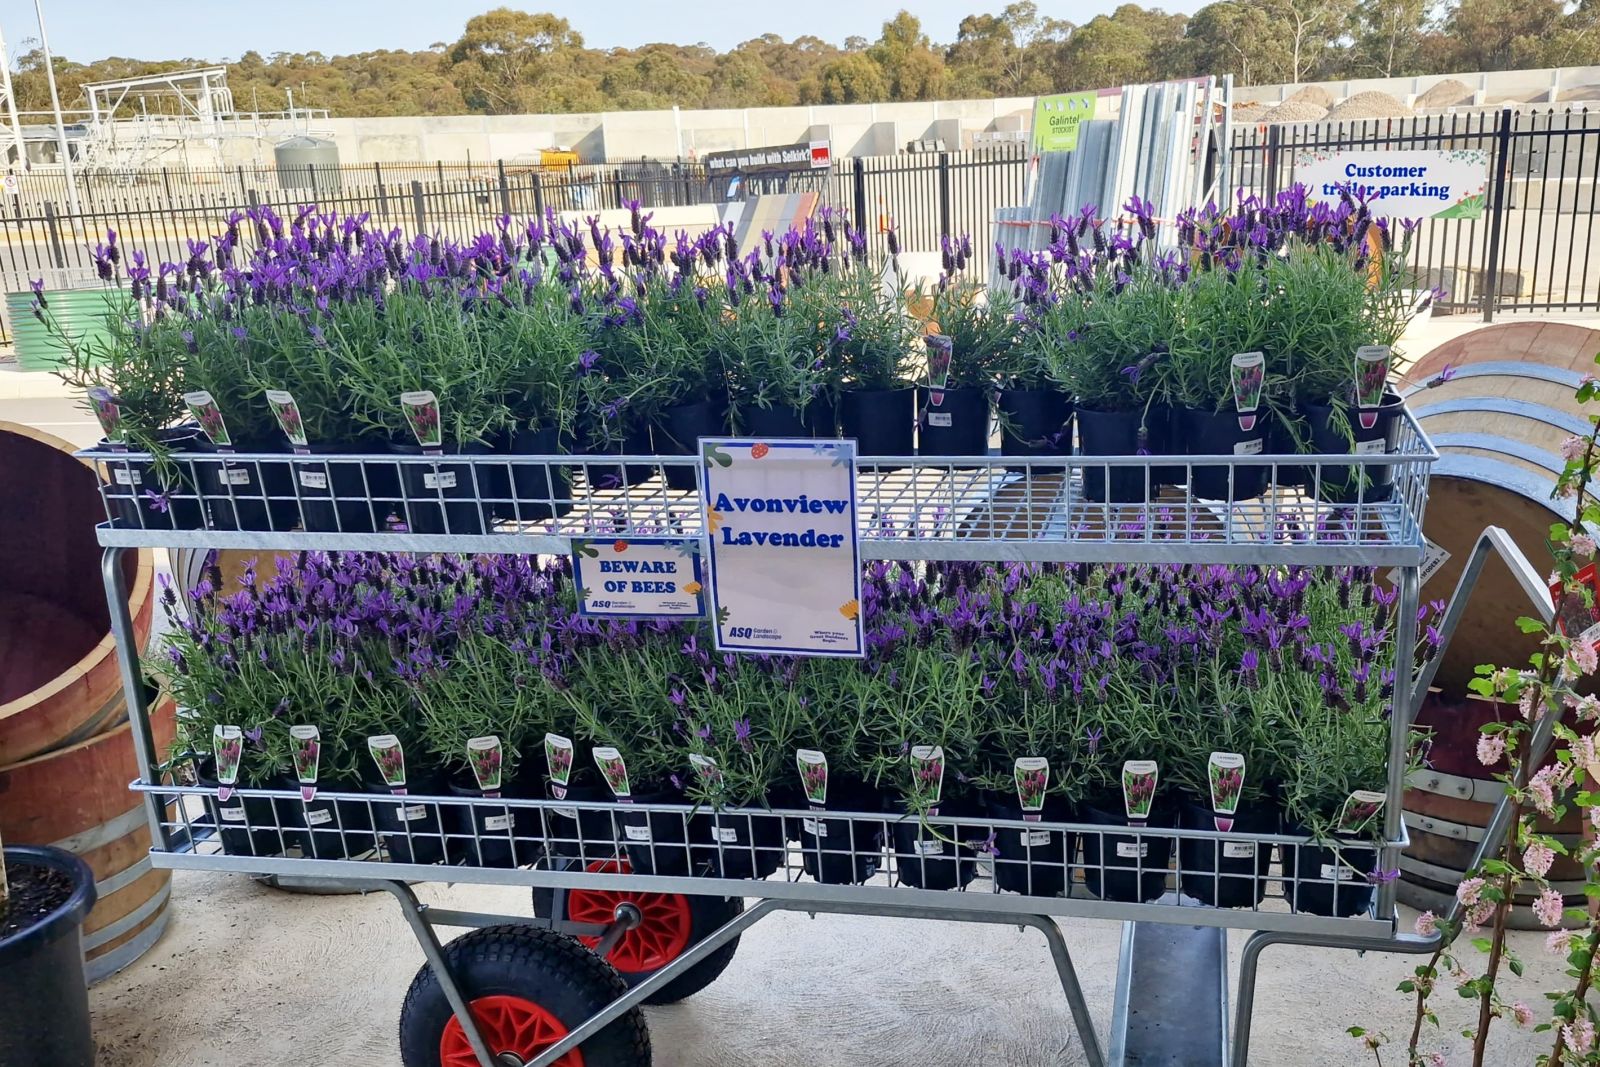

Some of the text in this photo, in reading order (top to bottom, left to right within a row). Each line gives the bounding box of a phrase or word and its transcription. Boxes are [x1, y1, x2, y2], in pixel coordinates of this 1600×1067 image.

[1049, 114, 1079, 126] Galintel
[709, 157, 725, 169] what
[737, 156, 749, 169] you
[766, 152, 782, 164] with
[782, 149, 810, 163] Selkirk?
[1345, 163, 1427, 178] Customer
[1379, 182, 1450, 201] parking
[713, 492, 849, 515] Avonview
[721, 526, 844, 548] Lavender
[599, 560, 677, 574] BEWARE
[604, 580, 676, 594] OF BEES
[591, 600, 611, 609] ASQ
[729, 626, 753, 640] ASQ
